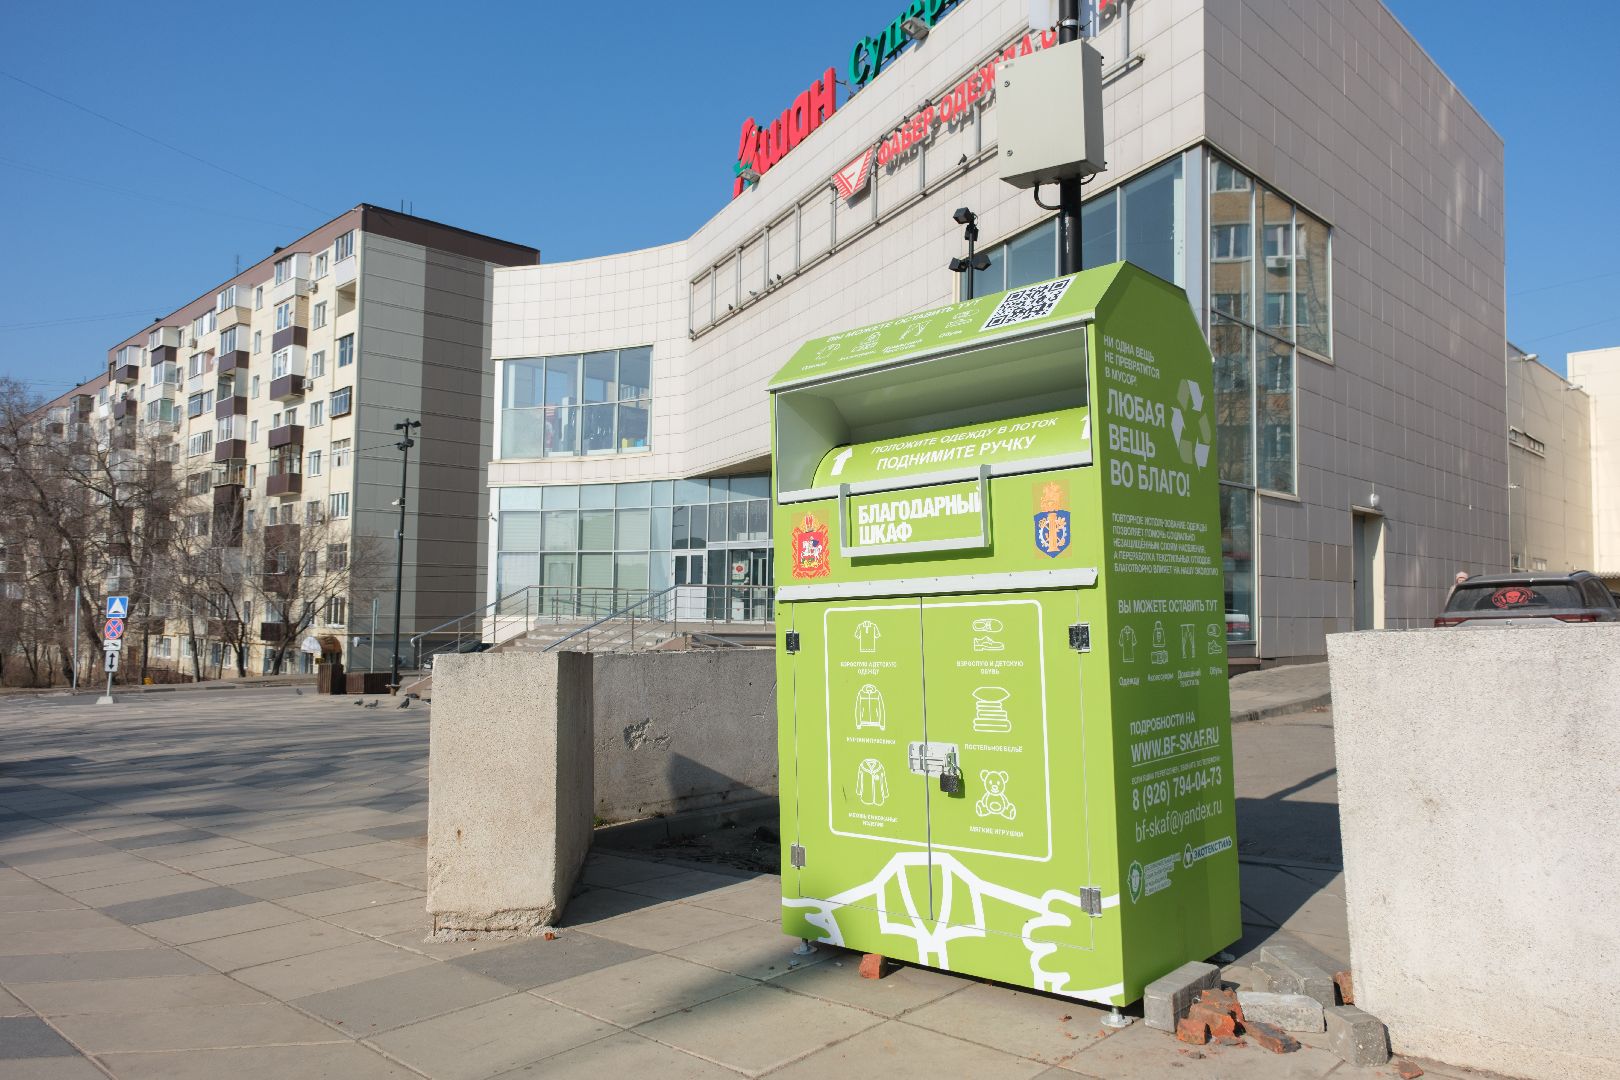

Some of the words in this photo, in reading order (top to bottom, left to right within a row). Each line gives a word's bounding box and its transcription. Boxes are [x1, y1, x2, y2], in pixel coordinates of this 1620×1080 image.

[877, 105, 935, 166] ФАБЕР
[1103, 335, 1114, 347] НИ
[1115, 339, 1135, 354] ОДНА
[1135, 345, 1155, 363] ВЕЩЬ
[1104, 351, 1115, 364] НЕ
[1115, 355, 1161, 379] ПРЕВРАТИТСЯ
[1105, 367, 1111, 378] В
[1107, 388, 1165, 428] ЛЮБАЯ
[871, 437, 938, 454] ПОЛОЖИТЕ
[940, 427, 996, 443] ОДЕЖДУ
[997, 425, 1008, 435] В
[1009, 417, 1059, 433] ЛОТОК
[876, 444, 976, 471] ПОДНИМИТЕ
[979, 434, 1037, 456] РУЧКУ
[1109, 423, 1156, 462] ВЕЩЬ
[1110, 459, 1133, 488] ВО
[1138, 463, 1191, 497] БЛАГО!
[858, 485, 981, 525] БЛАГОДАРНЫЙ
[859, 521, 913, 545] ШКАФ
[1113, 525, 1144, 537] ПОЗВОЛЯЕТ
[1118, 600, 1131, 614] ВЫ
[1133, 600, 1167, 613] МОЖЕТЕ
[1169, 599, 1204, 612] ОСТАВИТЬ
[1205, 599, 1218, 611] ТУТ
[1130, 713, 1185, 735] ПОДРОБНОСТИ
[1185, 711, 1196, 724] НА
[964, 743, 1003, 752] ПОСТЕЛЬНОЕ
[1131, 726, 1220, 763] WWW.BF-SKAF.RU
[1132, 788, 1139, 811] 8
[1143, 780, 1170, 813] (926)
[1173, 766, 1222, 798] 794-04-73
[1135, 799, 1223, 843] bf-skaf@yandex.ru
[1193, 838, 1232, 859] ЭКОТЕКСТИЛЬ
